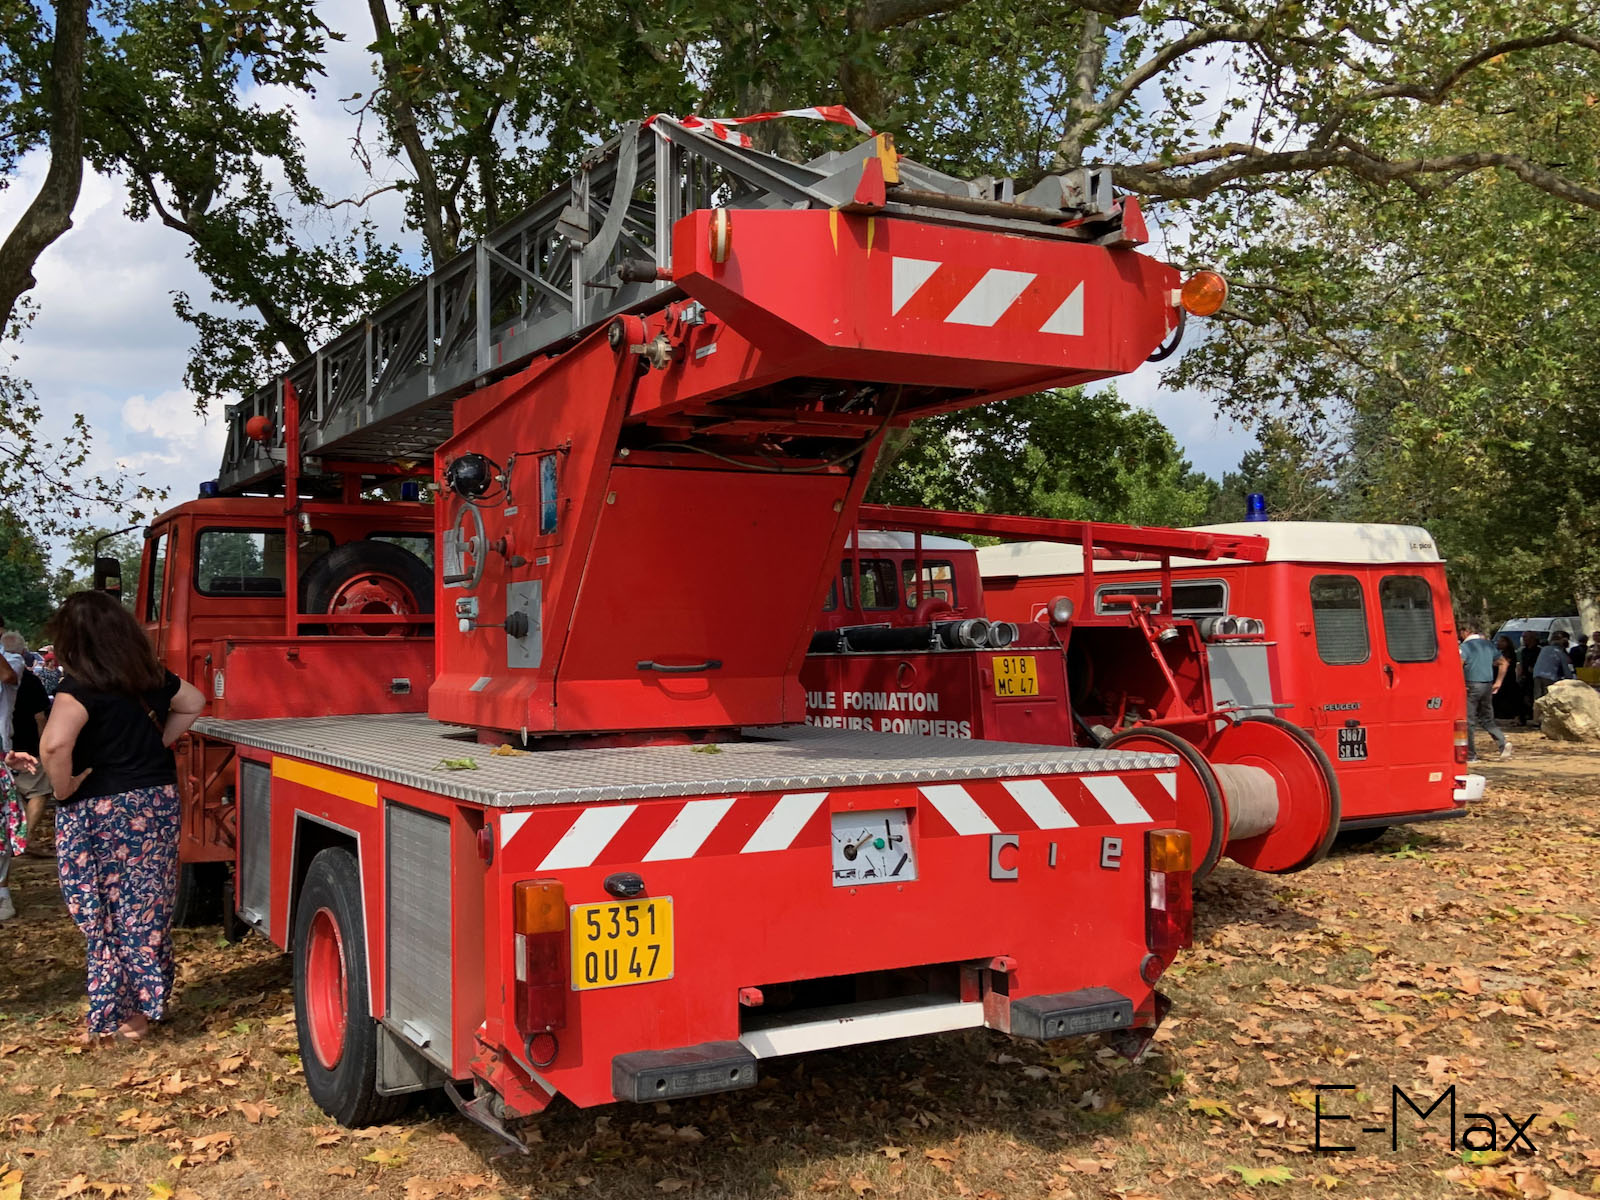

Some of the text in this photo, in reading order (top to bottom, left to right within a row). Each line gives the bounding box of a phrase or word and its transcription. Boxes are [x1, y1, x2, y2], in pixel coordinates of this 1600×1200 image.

[1003, 658, 1026, 674] 918
[998, 677, 1034, 695] MC 47
[805, 691, 939, 712] ULE FORMATION
[1323, 703, 1361, 712] PEUGEOT
[1427, 697, 1442, 709] J9
[881, 718, 971, 739] POMPIERS
[1353, 743, 1365, 757] 64
[587, 904, 655, 942] 5351
[585, 944, 661, 984] QU 47
